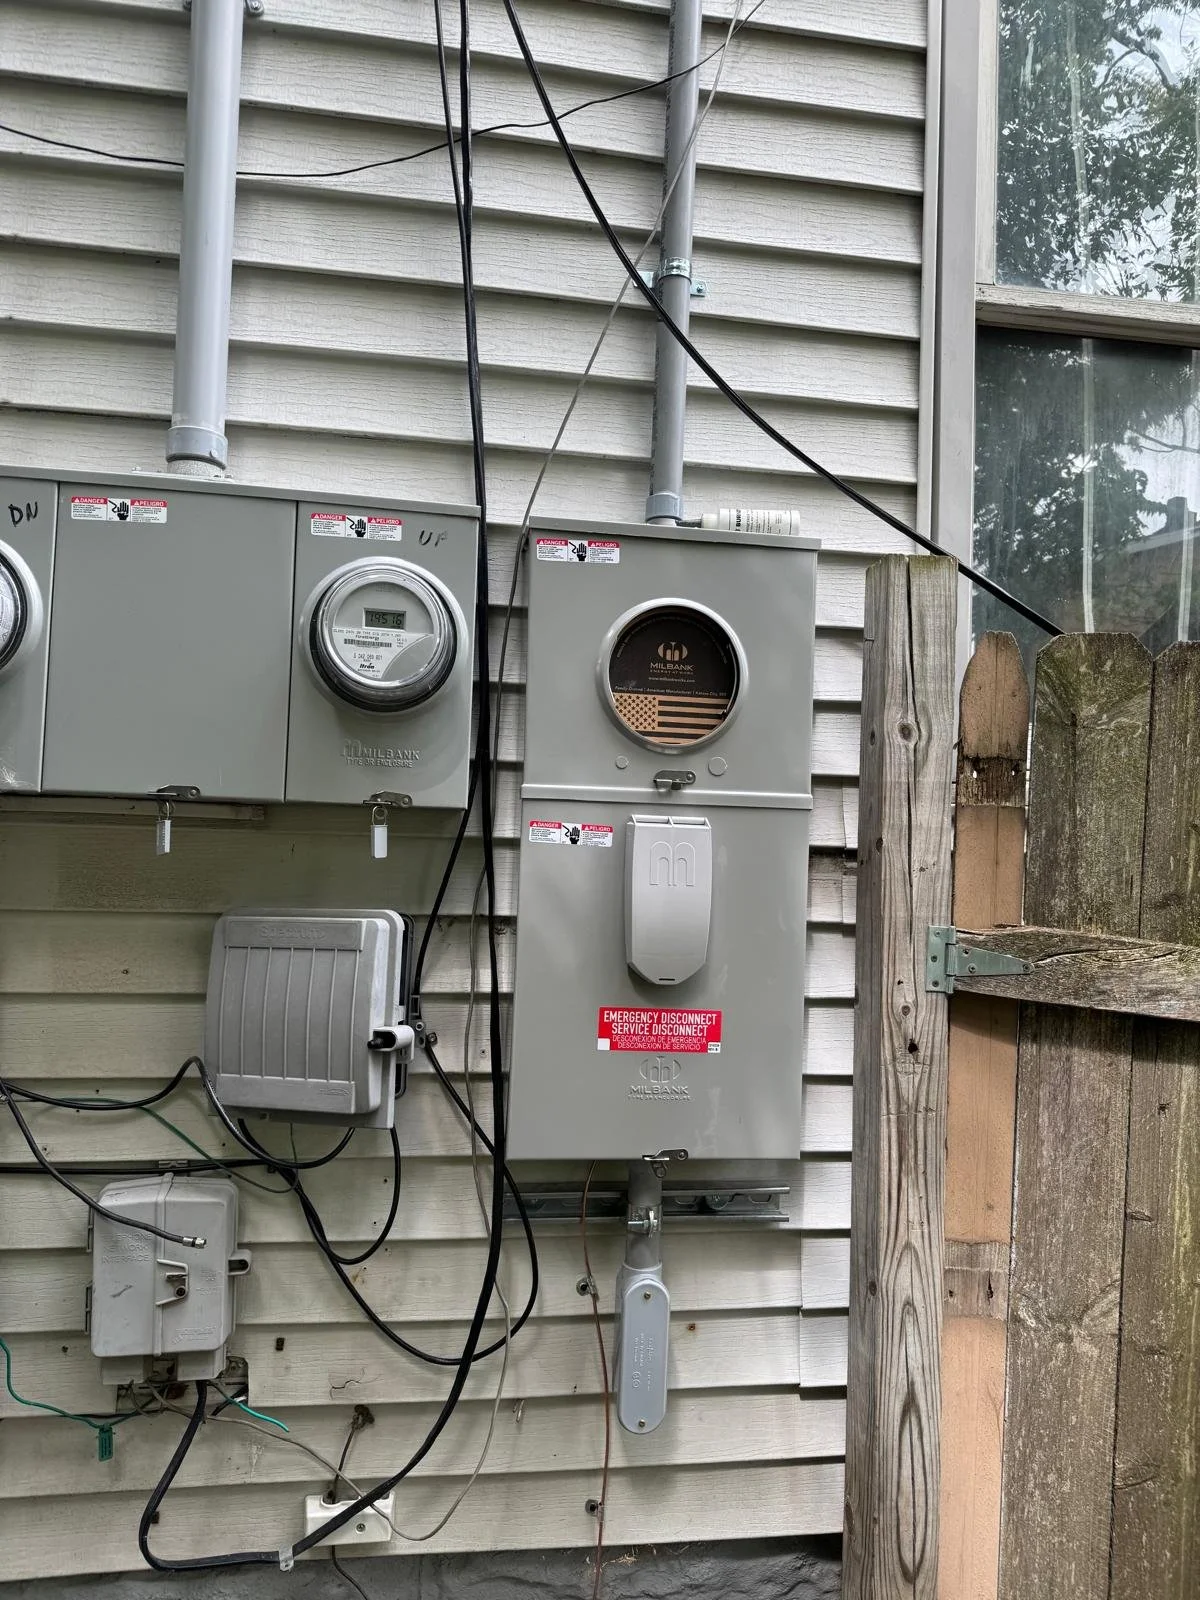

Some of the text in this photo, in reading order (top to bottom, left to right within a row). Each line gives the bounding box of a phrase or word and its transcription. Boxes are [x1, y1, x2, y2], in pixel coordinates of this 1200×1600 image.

[8, 501, 38, 528] DN
[650, 662, 694, 671] MILBANK
[363, 747, 420, 760] MILBANK
[604, 1010, 717, 1025] EMERGENCY DISCONNECT
[611, 1023, 708, 1036] SERVICE DISCONNECT
[612, 1035, 656, 1043] DESCONEXION
[630, 1085, 688, 1095] MILBANK
